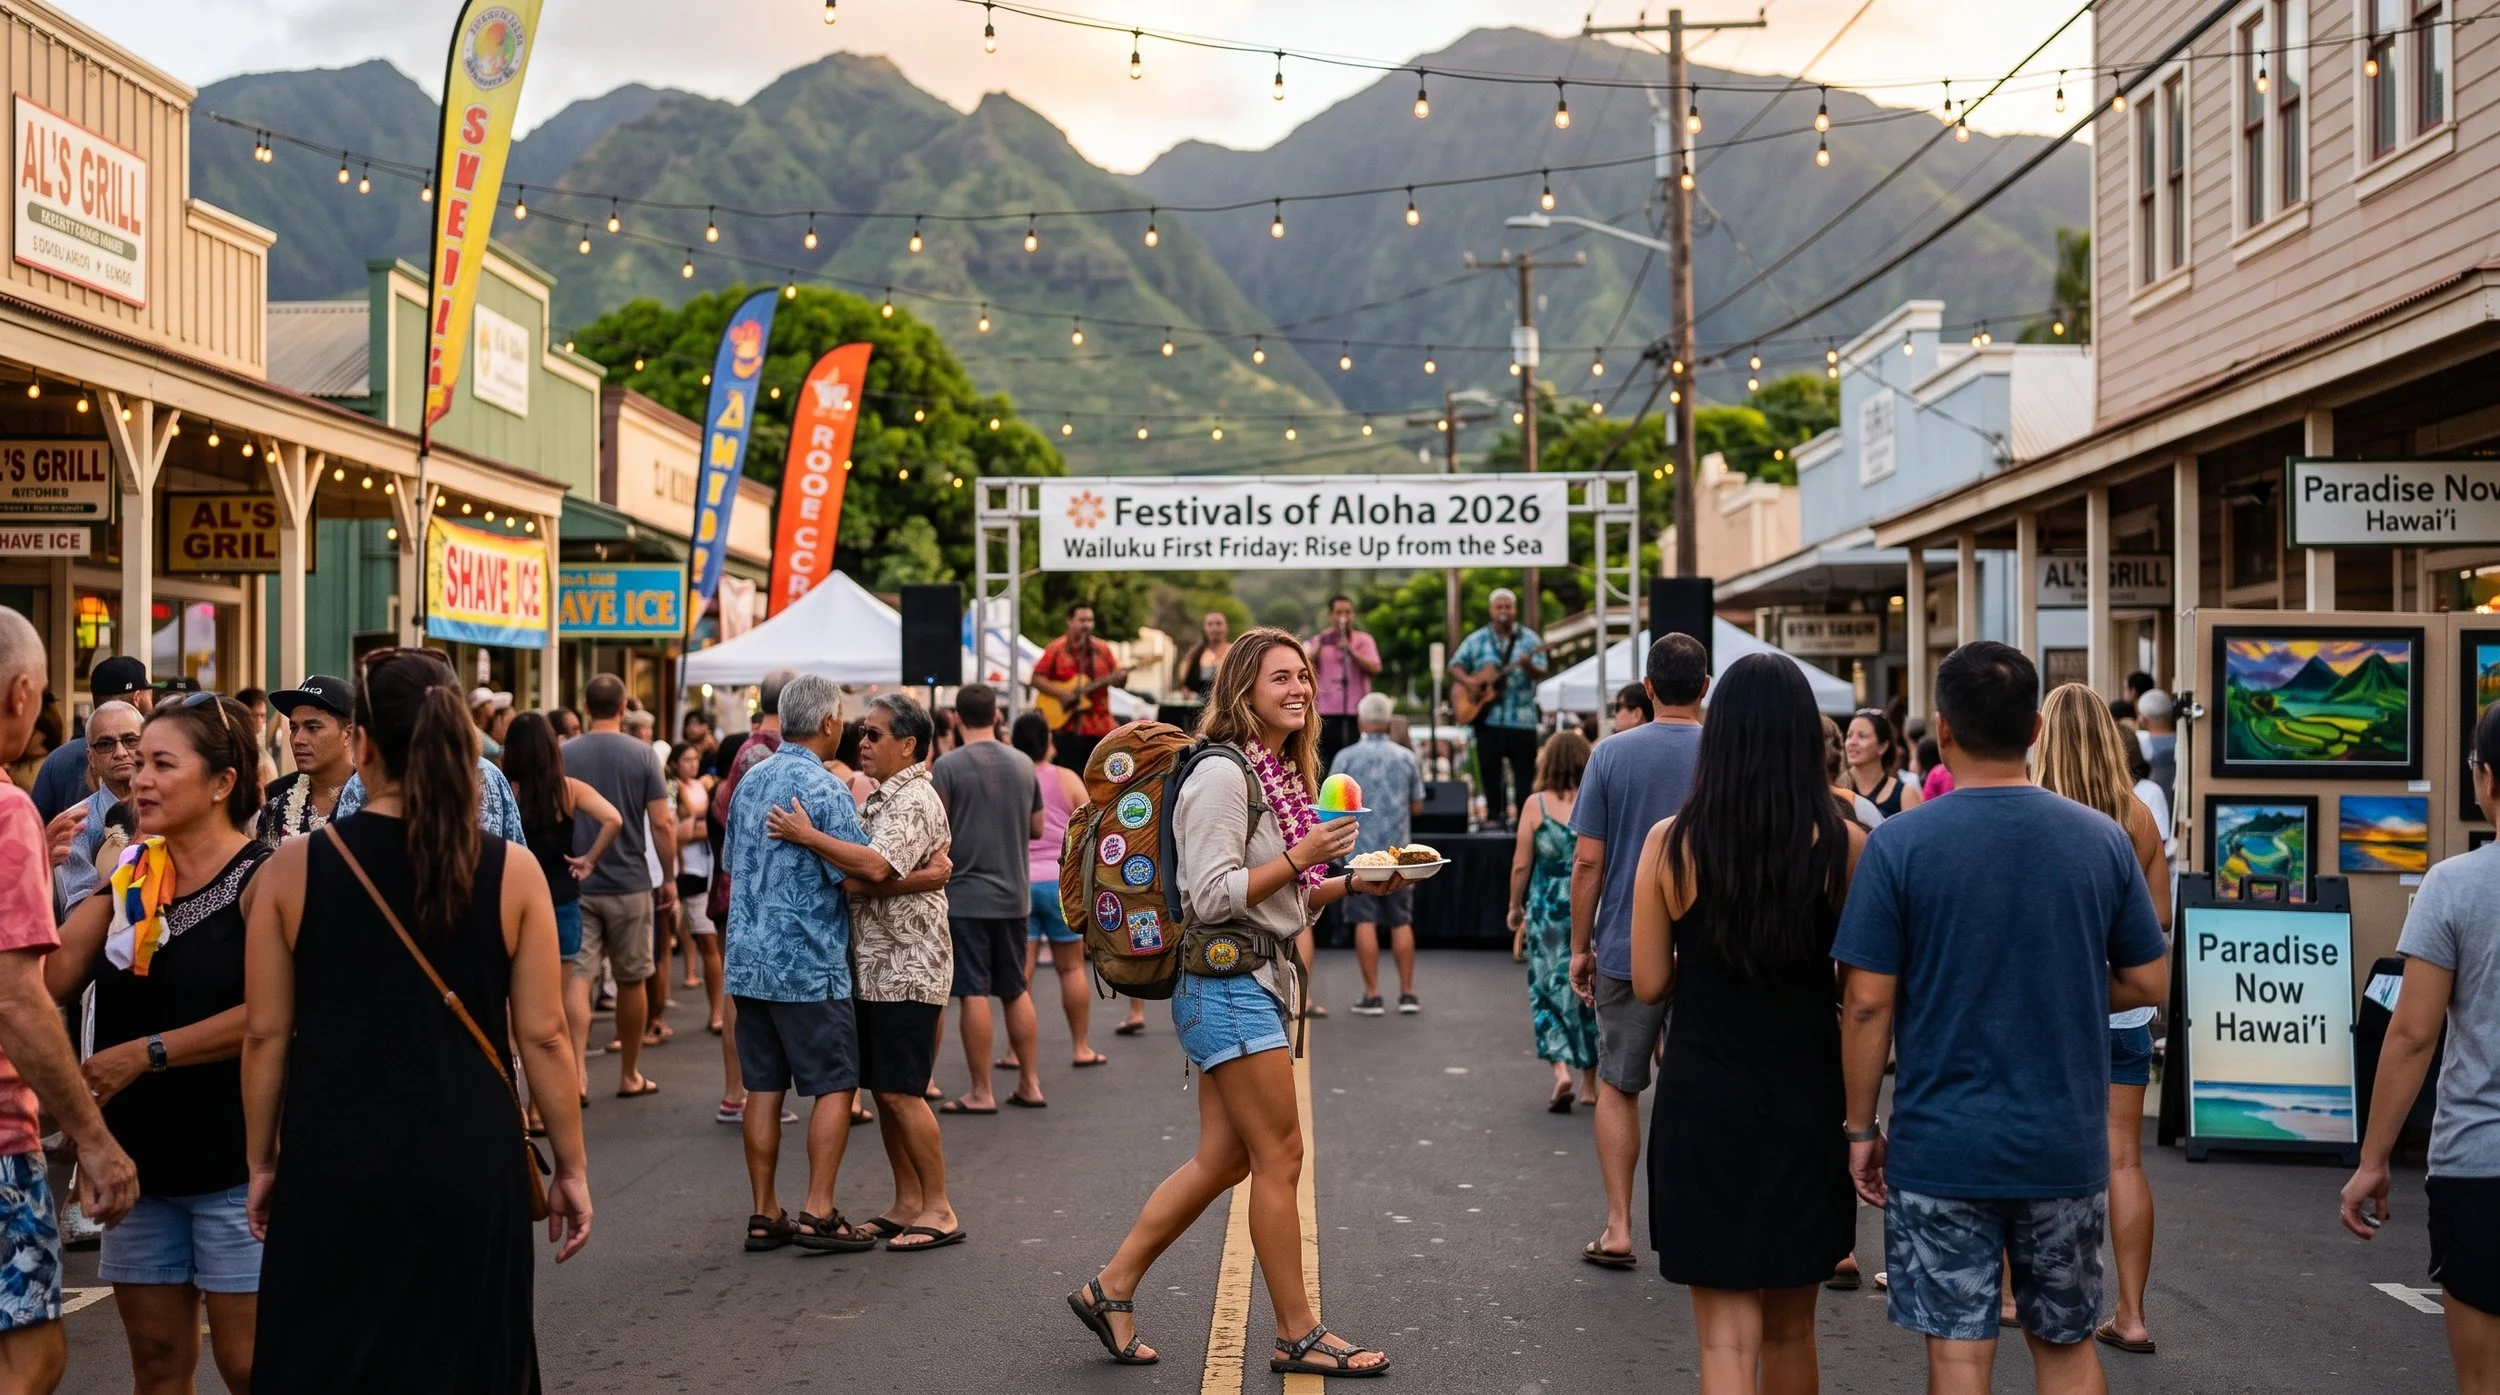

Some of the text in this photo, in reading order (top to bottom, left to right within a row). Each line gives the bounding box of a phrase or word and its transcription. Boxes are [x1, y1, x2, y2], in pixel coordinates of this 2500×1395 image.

[22, 119, 72, 206] AL'S
[80, 147, 141, 236] GRILL
[33, 448, 105, 482] GRILL
[2304, 473, 2435, 503] Paradise
[190, 502, 276, 529] AL'S
[1115, 494, 1541, 526] Festivals of Aloha 2026
[50, 533, 81, 549] ICE
[183, 532, 281, 559] GRIL
[1064, 535, 1543, 562] Wailuku First Friday: Rise Up from the Sea
[447, 545, 509, 615] SHAVE
[516, 559, 541, 617] ICE
[625, 591, 675, 625] ICE
[2199, 932, 2339, 966] Paradise
[2235, 972, 2304, 1004] Now
